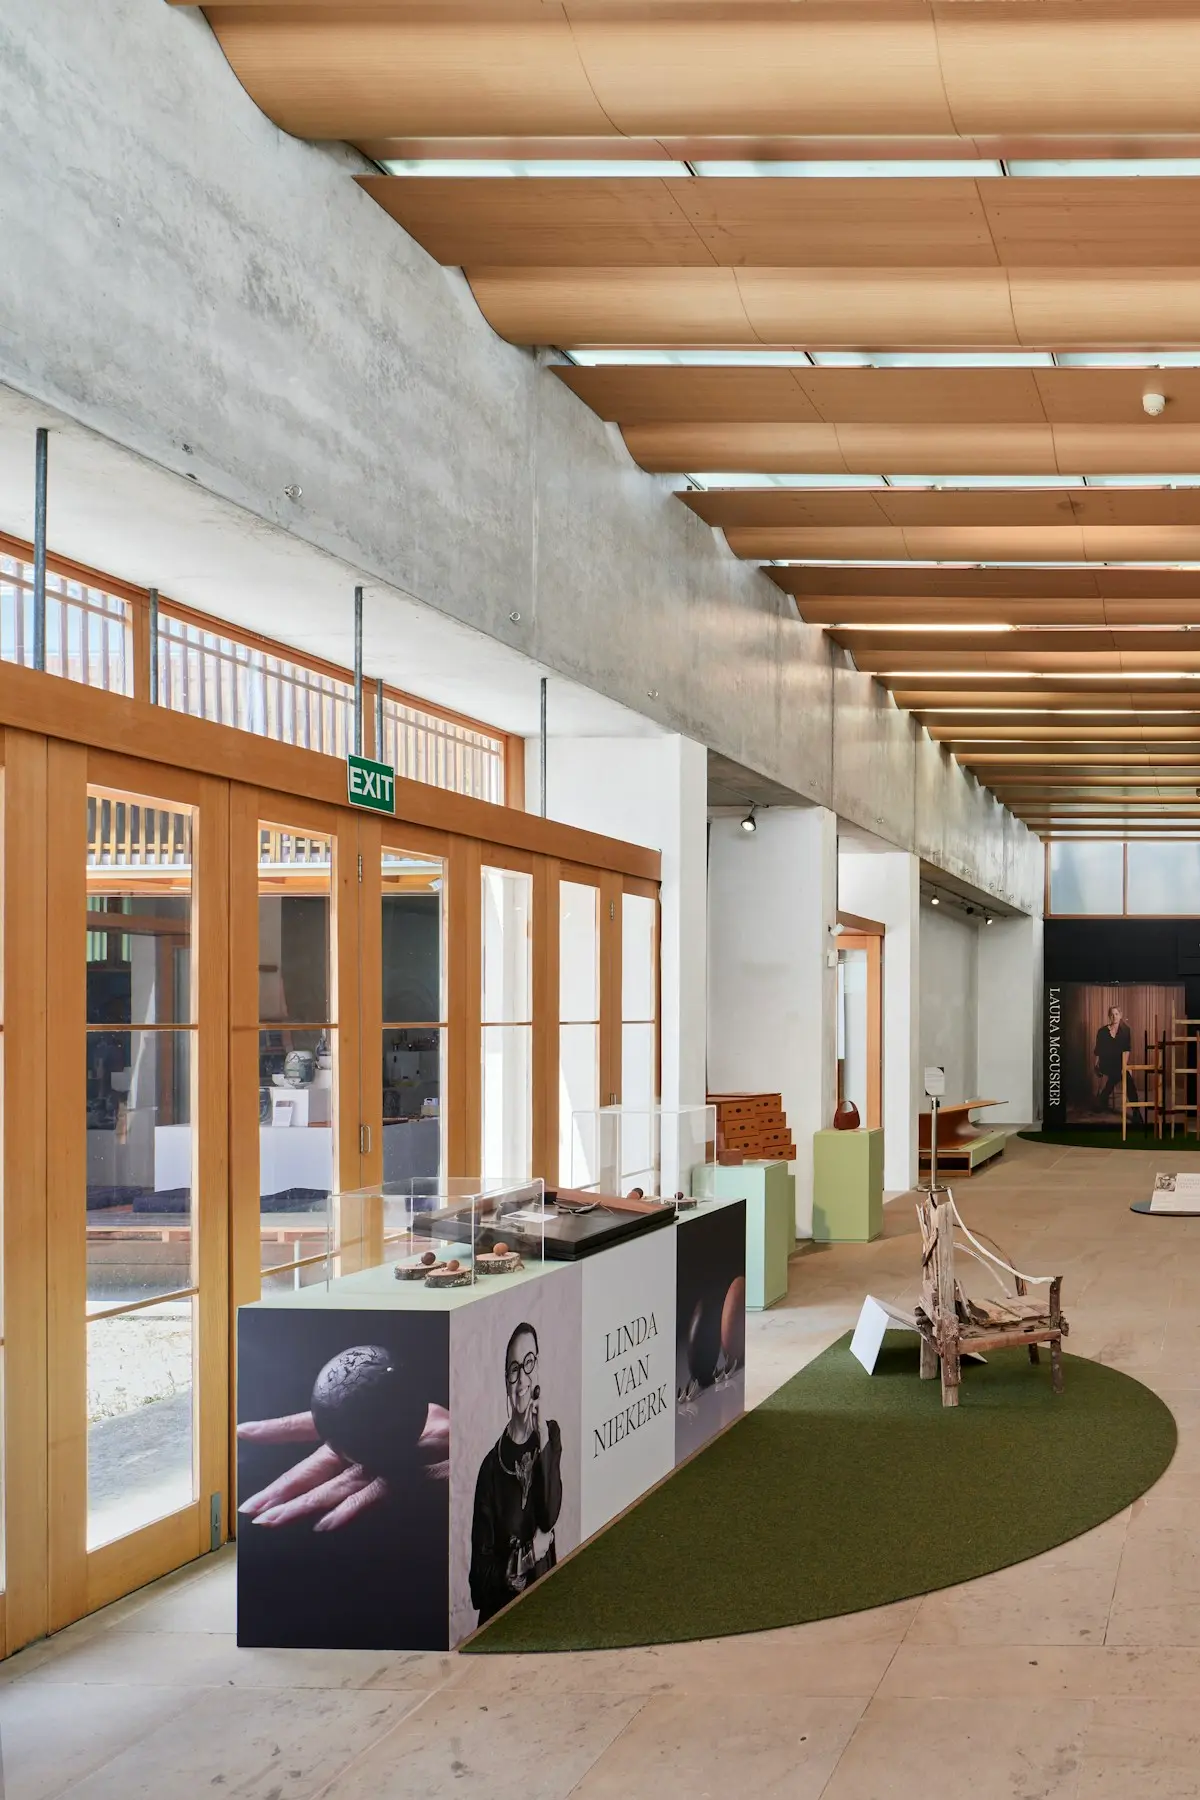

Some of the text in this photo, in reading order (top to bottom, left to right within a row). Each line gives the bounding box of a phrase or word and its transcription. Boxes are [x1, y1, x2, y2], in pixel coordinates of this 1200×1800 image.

[349, 765, 394, 802] EXIT
[1049, 987, 1061, 1107] LAURA McCUSKER
[604, 1311, 659, 1363] LINDA
[613, 1354, 650, 1398] VAN
[593, 1383, 667, 1459] NIEKERK
